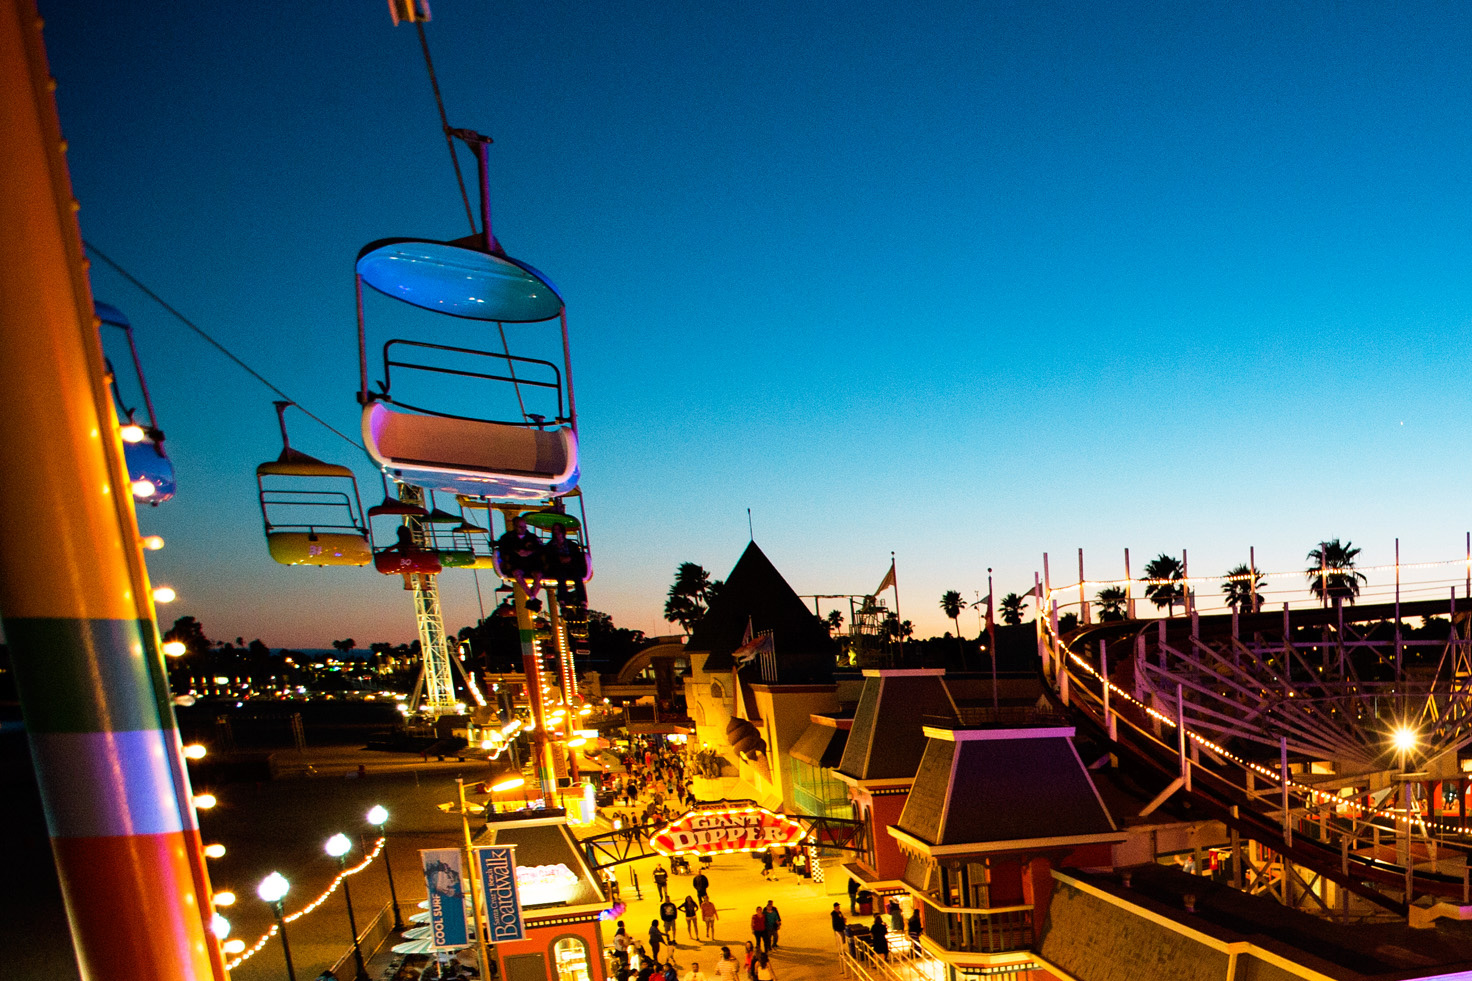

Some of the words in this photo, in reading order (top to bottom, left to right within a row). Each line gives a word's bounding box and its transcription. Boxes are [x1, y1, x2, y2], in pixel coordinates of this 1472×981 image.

[691, 815, 761, 829] GIANT
[670, 826, 787, 849] DIPPER
[486, 868, 495, 887] Beach
[432, 893, 442, 917] SURF
[485, 849, 518, 941] Boardwalk
[489, 888, 498, 909] Cruz
[435, 917, 446, 945] COOL
